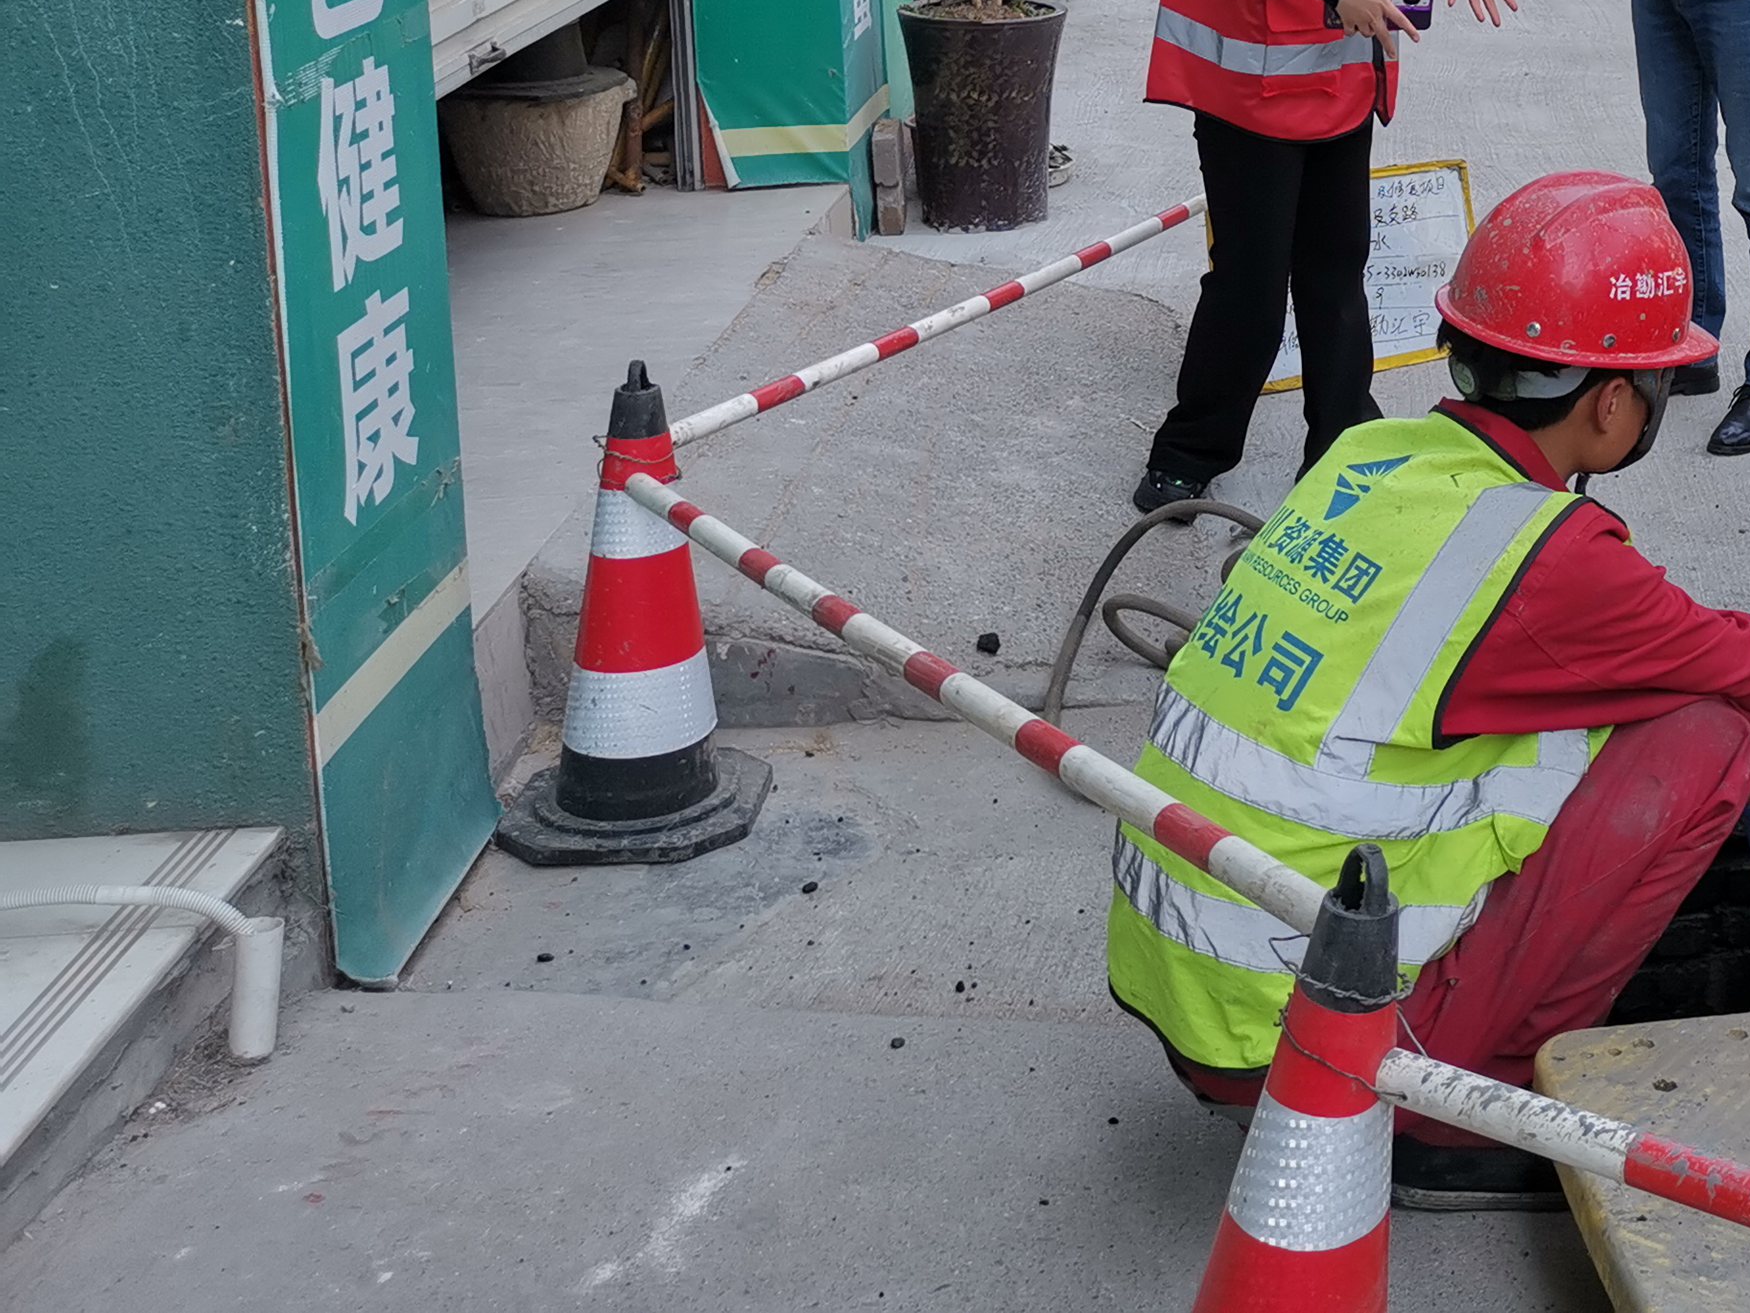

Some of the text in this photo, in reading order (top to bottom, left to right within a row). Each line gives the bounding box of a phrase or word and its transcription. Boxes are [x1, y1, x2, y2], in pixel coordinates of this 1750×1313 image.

[1609, 267, 1688, 302] 冶勘汇宇
[1252, 555, 1300, 596] RESOURCES
[1299, 588, 1350, 624] GROUP
[1256, 506, 1384, 605] 川资源集团
